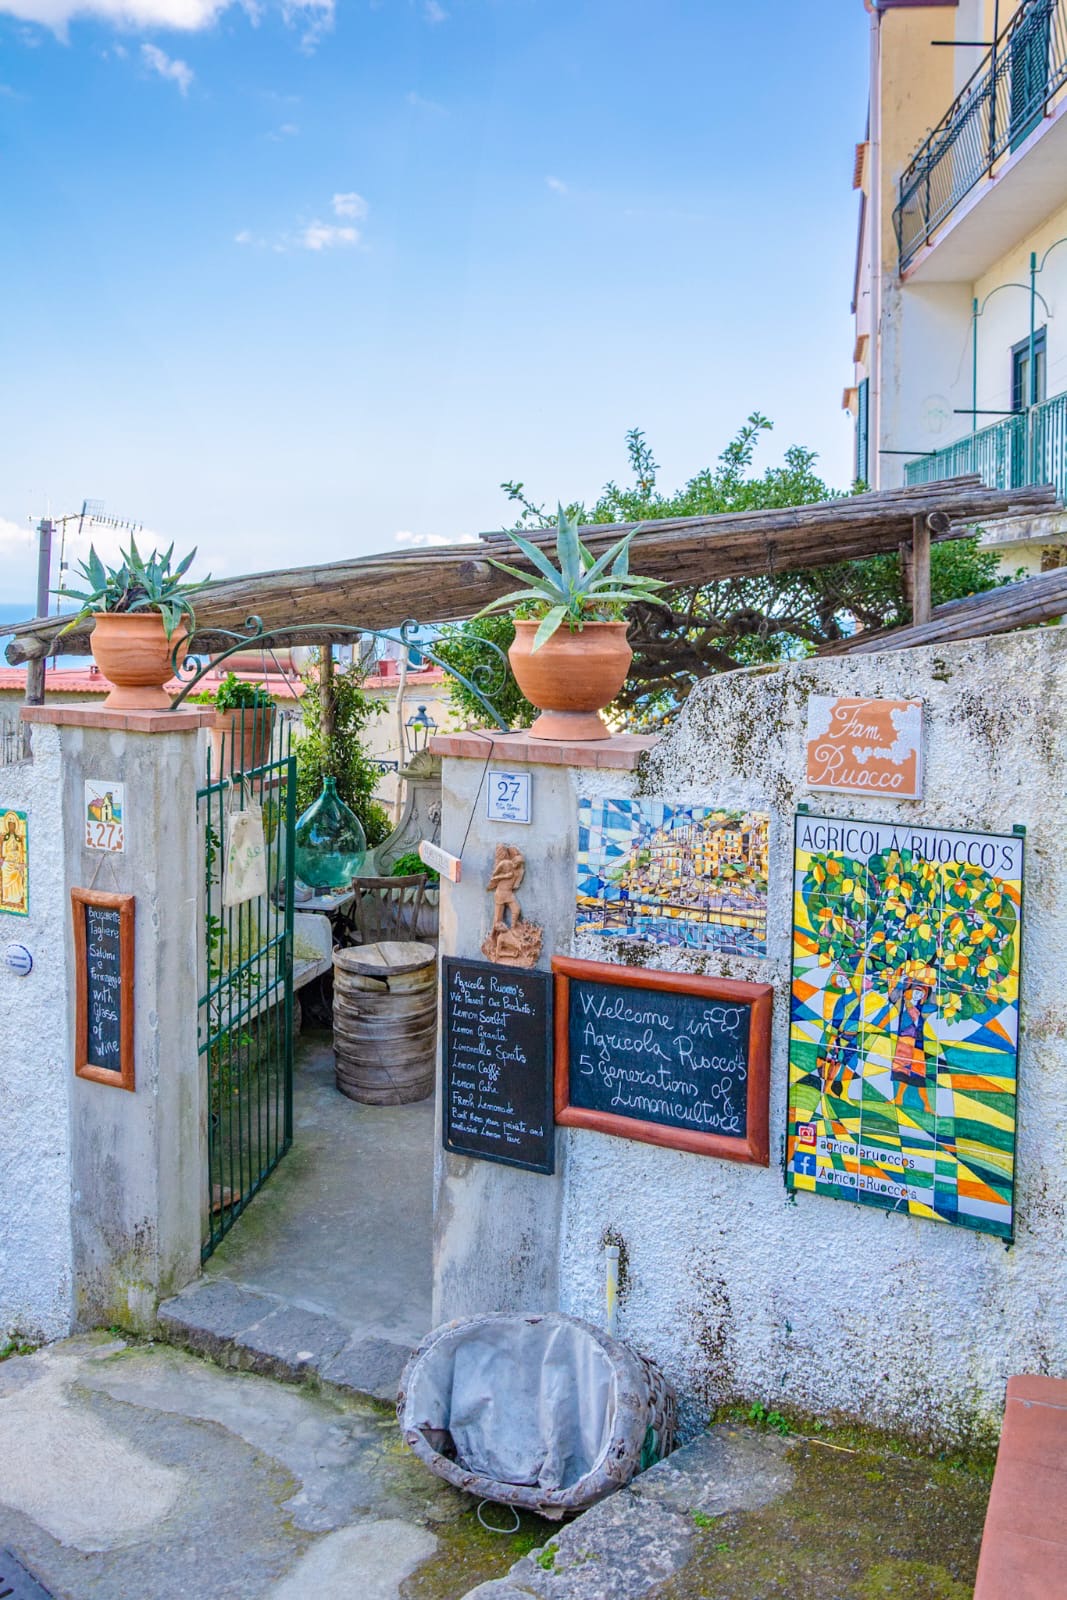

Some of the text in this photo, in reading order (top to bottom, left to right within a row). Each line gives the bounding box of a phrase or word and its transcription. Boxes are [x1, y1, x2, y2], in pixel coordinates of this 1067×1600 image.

[829, 701, 883, 741] Fam.
[808, 744, 904, 788] Ruocco
[497, 781, 521, 802] 27
[96, 823, 115, 848] 27
[801, 825, 1014, 871] AGRICOLA RUOCCO'S
[454, 971, 485, 993] Agricola
[452, 1003, 479, 1019] Lemon
[580, 991, 714, 1039] Welcome in
[92, 1021, 103, 1041] of
[452, 1020, 474, 1036] Lemon
[583, 1021, 673, 1063] Agricola
[452, 1053, 476, 1072] Lemon
[451, 1072, 476, 1091] Lemon
[579, 1054, 595, 1076] 5
[711, 1076, 733, 1118] of
